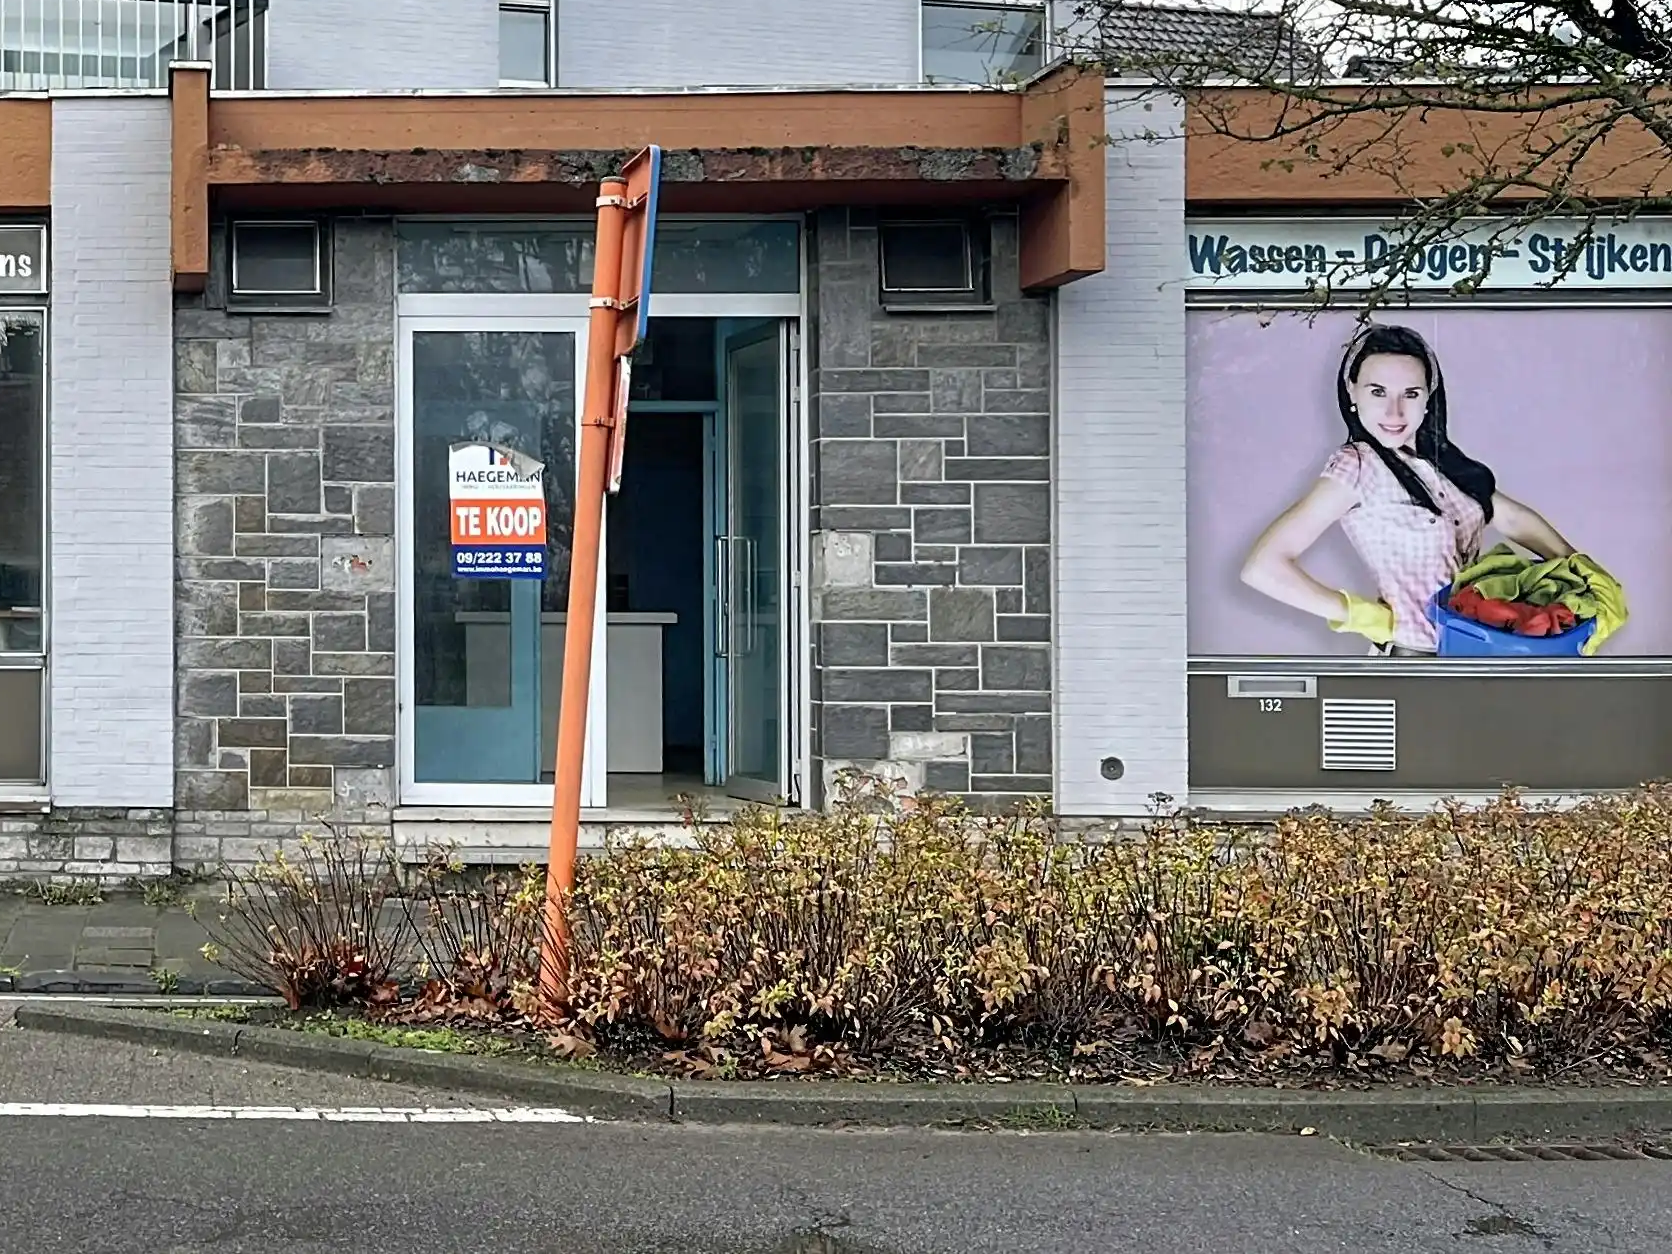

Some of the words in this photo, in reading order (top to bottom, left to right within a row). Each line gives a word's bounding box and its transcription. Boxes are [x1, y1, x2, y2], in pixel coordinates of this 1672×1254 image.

[1188, 234, 1327, 275] Wassen
[456, 470, 540, 483] HAEGEMN
[456, 507, 481, 536] TE
[486, 506, 542, 536] KOOP
[456, 552, 502, 564] 09/222
[505, 552, 522, 564] 37
[525, 552, 542, 564] 88
[1259, 699, 1282, 712] 132
